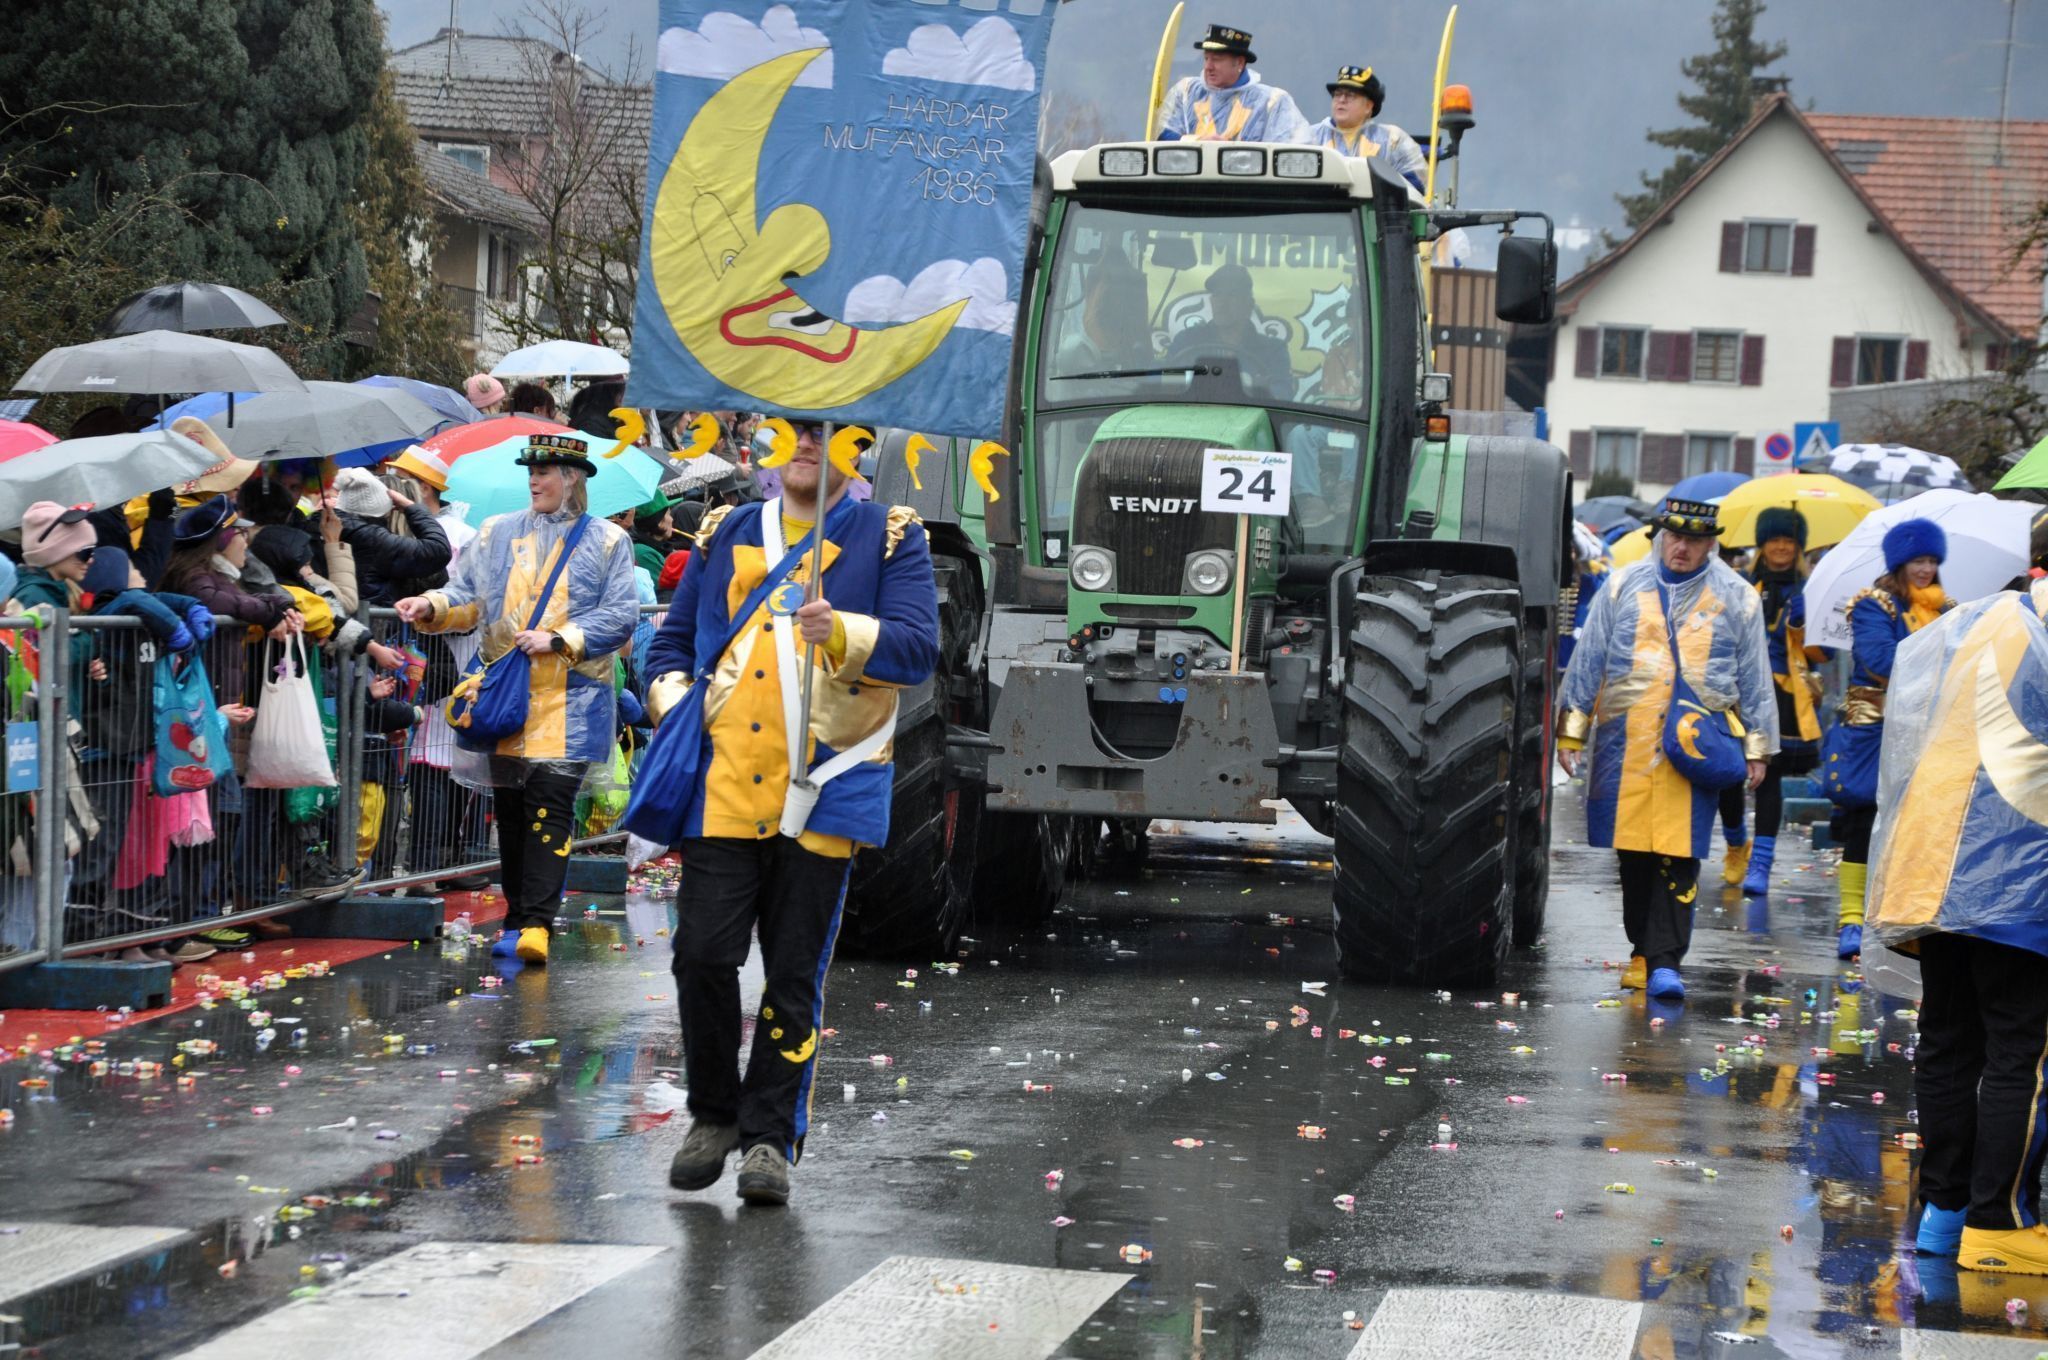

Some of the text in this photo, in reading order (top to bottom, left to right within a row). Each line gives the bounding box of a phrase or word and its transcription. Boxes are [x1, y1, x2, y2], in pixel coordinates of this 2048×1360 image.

[888, 94, 1008, 131] HARDAR
[824, 125, 1004, 163] MUFÄNGAR
[910, 167, 997, 206] 1986
[1218, 467, 1276, 502] 24
[1109, 496, 1198, 514] FENDT
